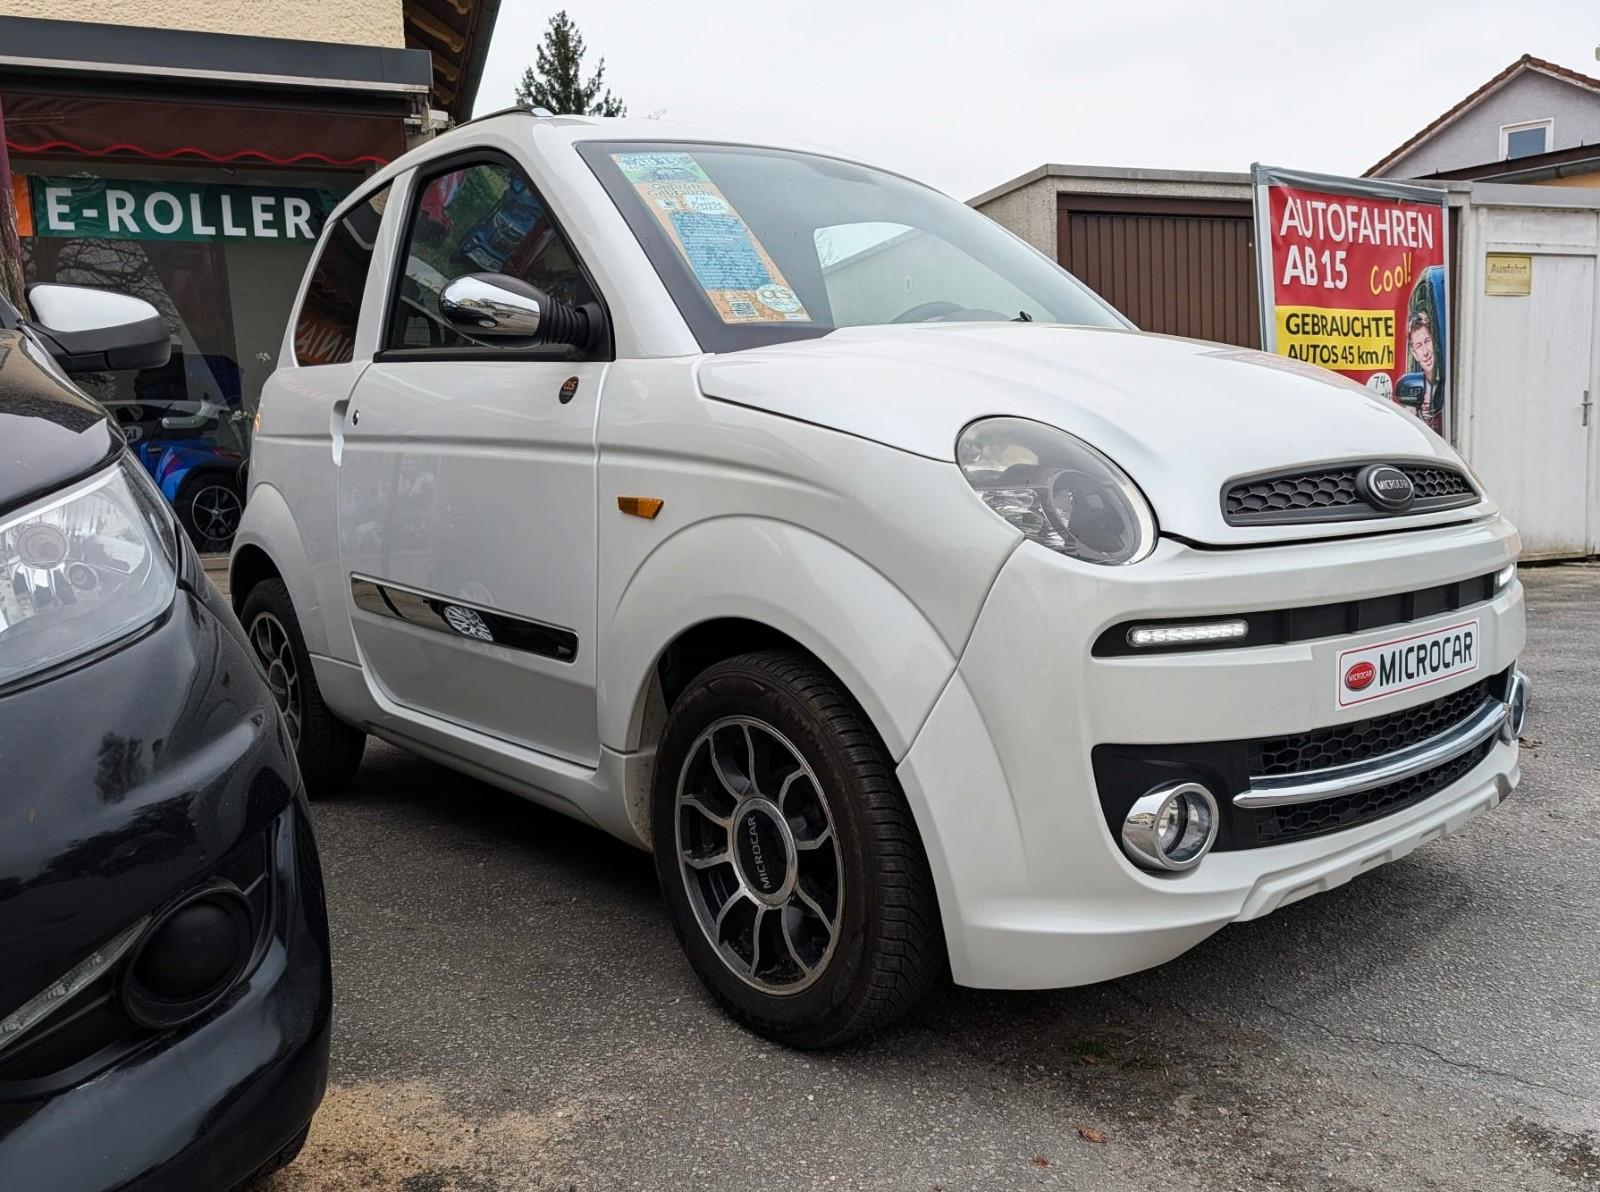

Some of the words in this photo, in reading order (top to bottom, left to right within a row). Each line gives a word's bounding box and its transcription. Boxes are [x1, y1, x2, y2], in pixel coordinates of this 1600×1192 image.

[45, 186, 316, 240] E-ROLLER
[1279, 196, 1434, 250] AUTOFAHREN
[1282, 245, 1319, 287] AB
[1321, 250, 1348, 290] 15
[1369, 252, 1412, 296] Cool!
[1285, 312, 1395, 338] GEBRAUCHTE
[1287, 343, 1339, 364] AUTOS
[1341, 345, 1355, 364] 45
[1357, 347, 1395, 367] km/h
[1348, 669, 1373, 682] MICROCAR
[1379, 631, 1473, 687] MICROCAR
[748, 816, 772, 889] MICROCAR
